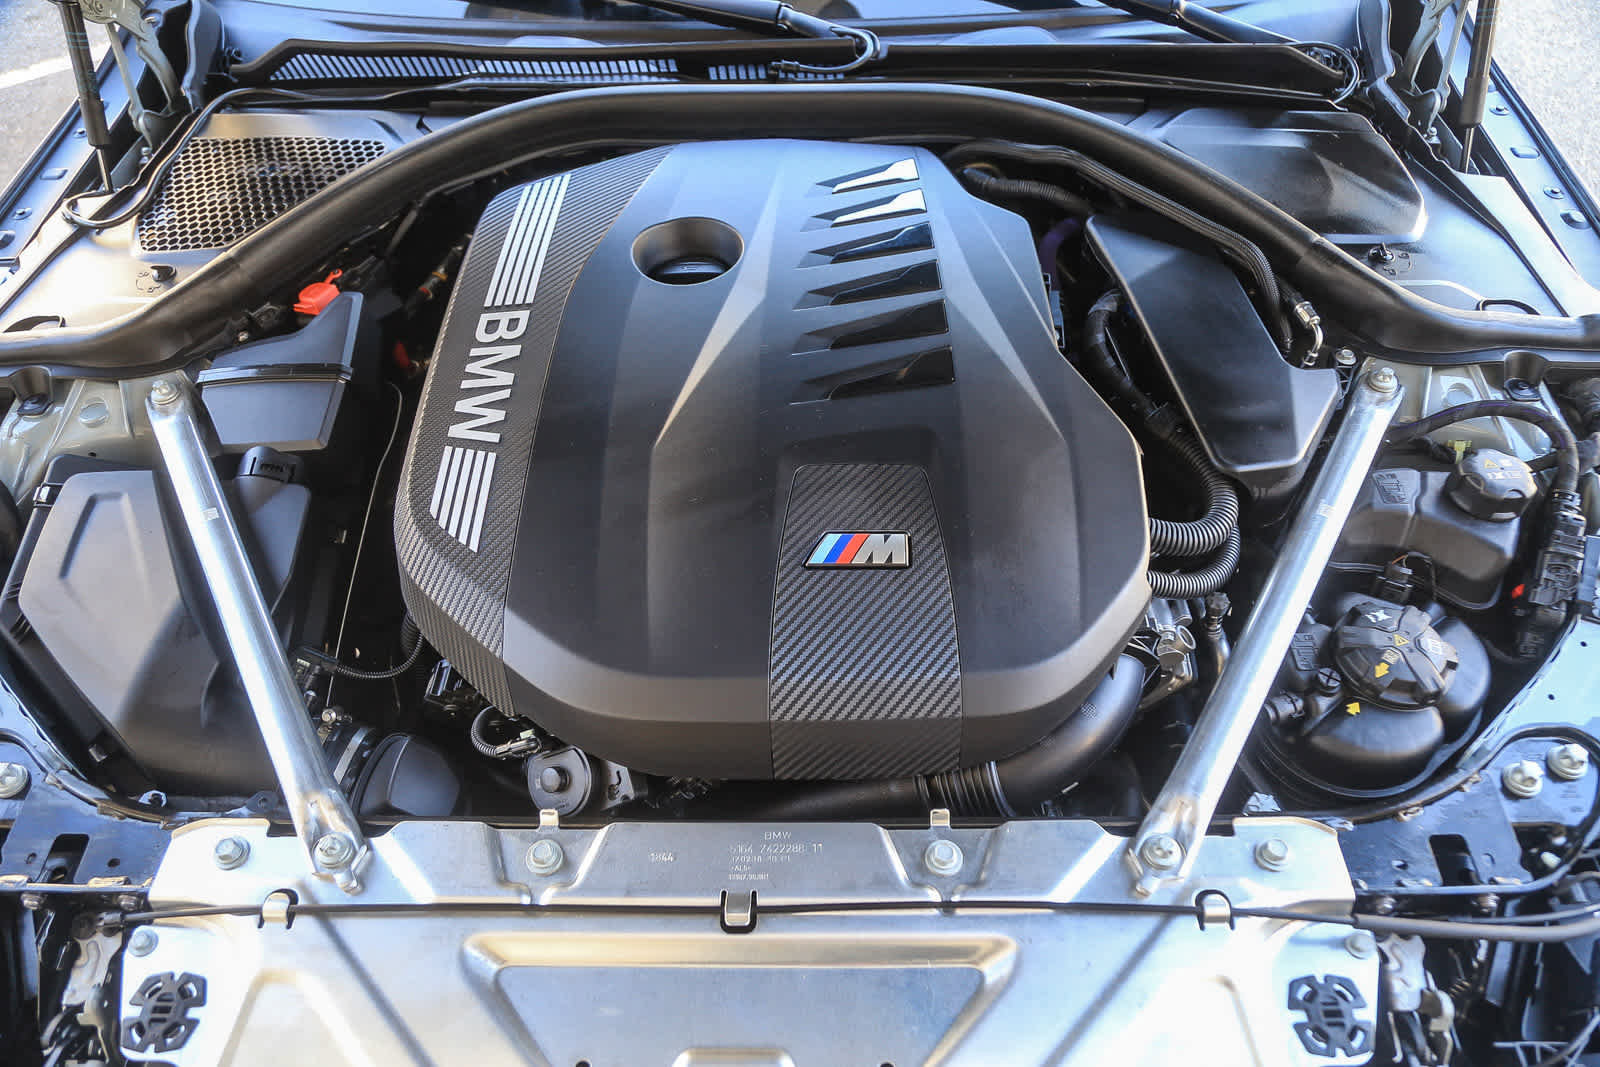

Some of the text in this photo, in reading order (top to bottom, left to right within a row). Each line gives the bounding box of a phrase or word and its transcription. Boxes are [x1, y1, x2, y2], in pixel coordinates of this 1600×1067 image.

[448, 310, 530, 443] BMW
[851, 533, 906, 564] M
[764, 831, 792, 840] BMW
